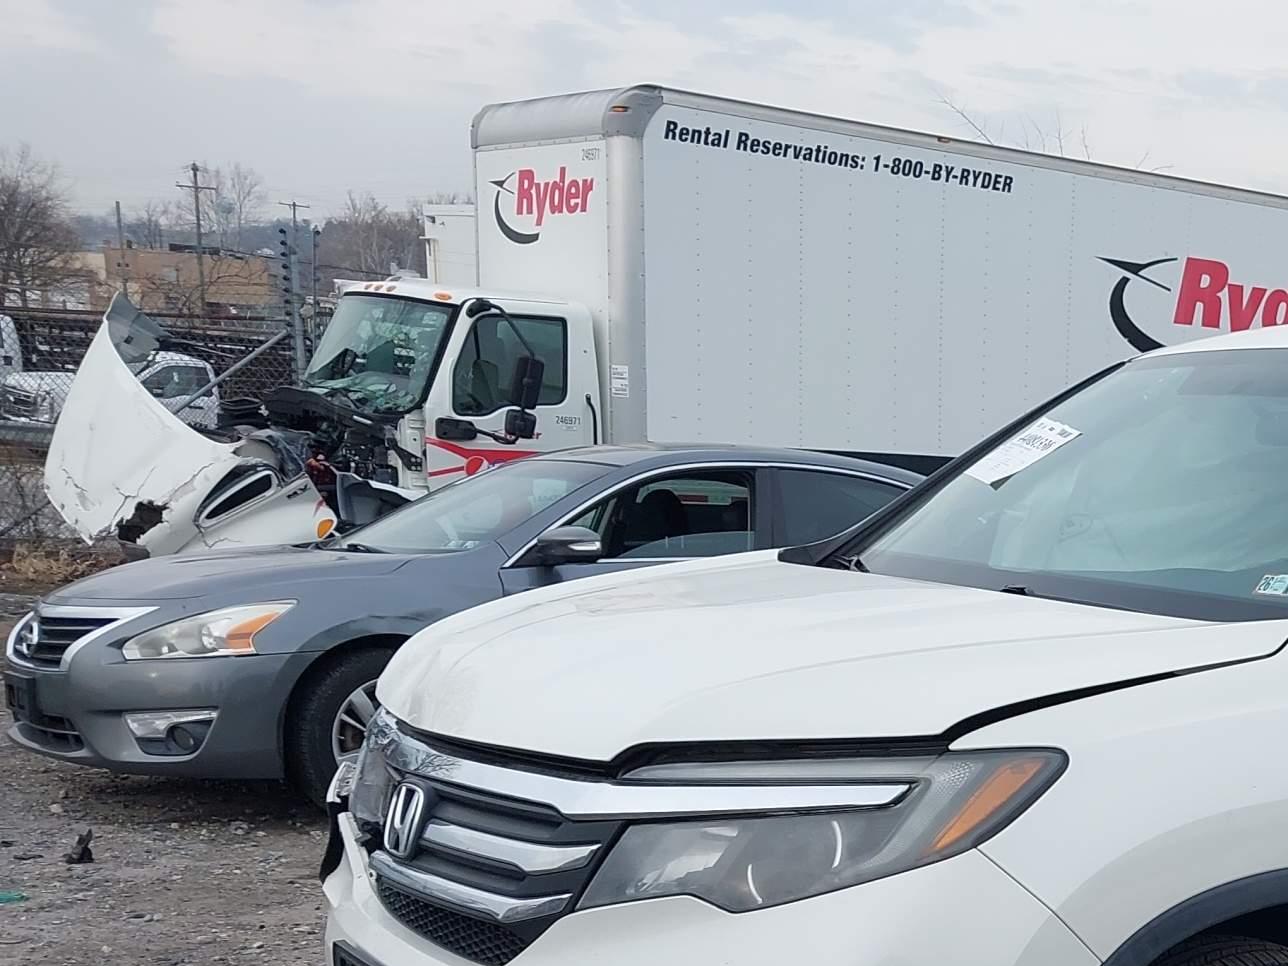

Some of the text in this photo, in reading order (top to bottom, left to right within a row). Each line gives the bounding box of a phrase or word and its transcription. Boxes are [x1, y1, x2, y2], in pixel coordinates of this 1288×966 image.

[664, 120, 1014, 193] Rental Reservations: 1-800-BY-RYDER
[516, 166, 594, 227] Ryder
[555, 415, 581, 425] 246971
